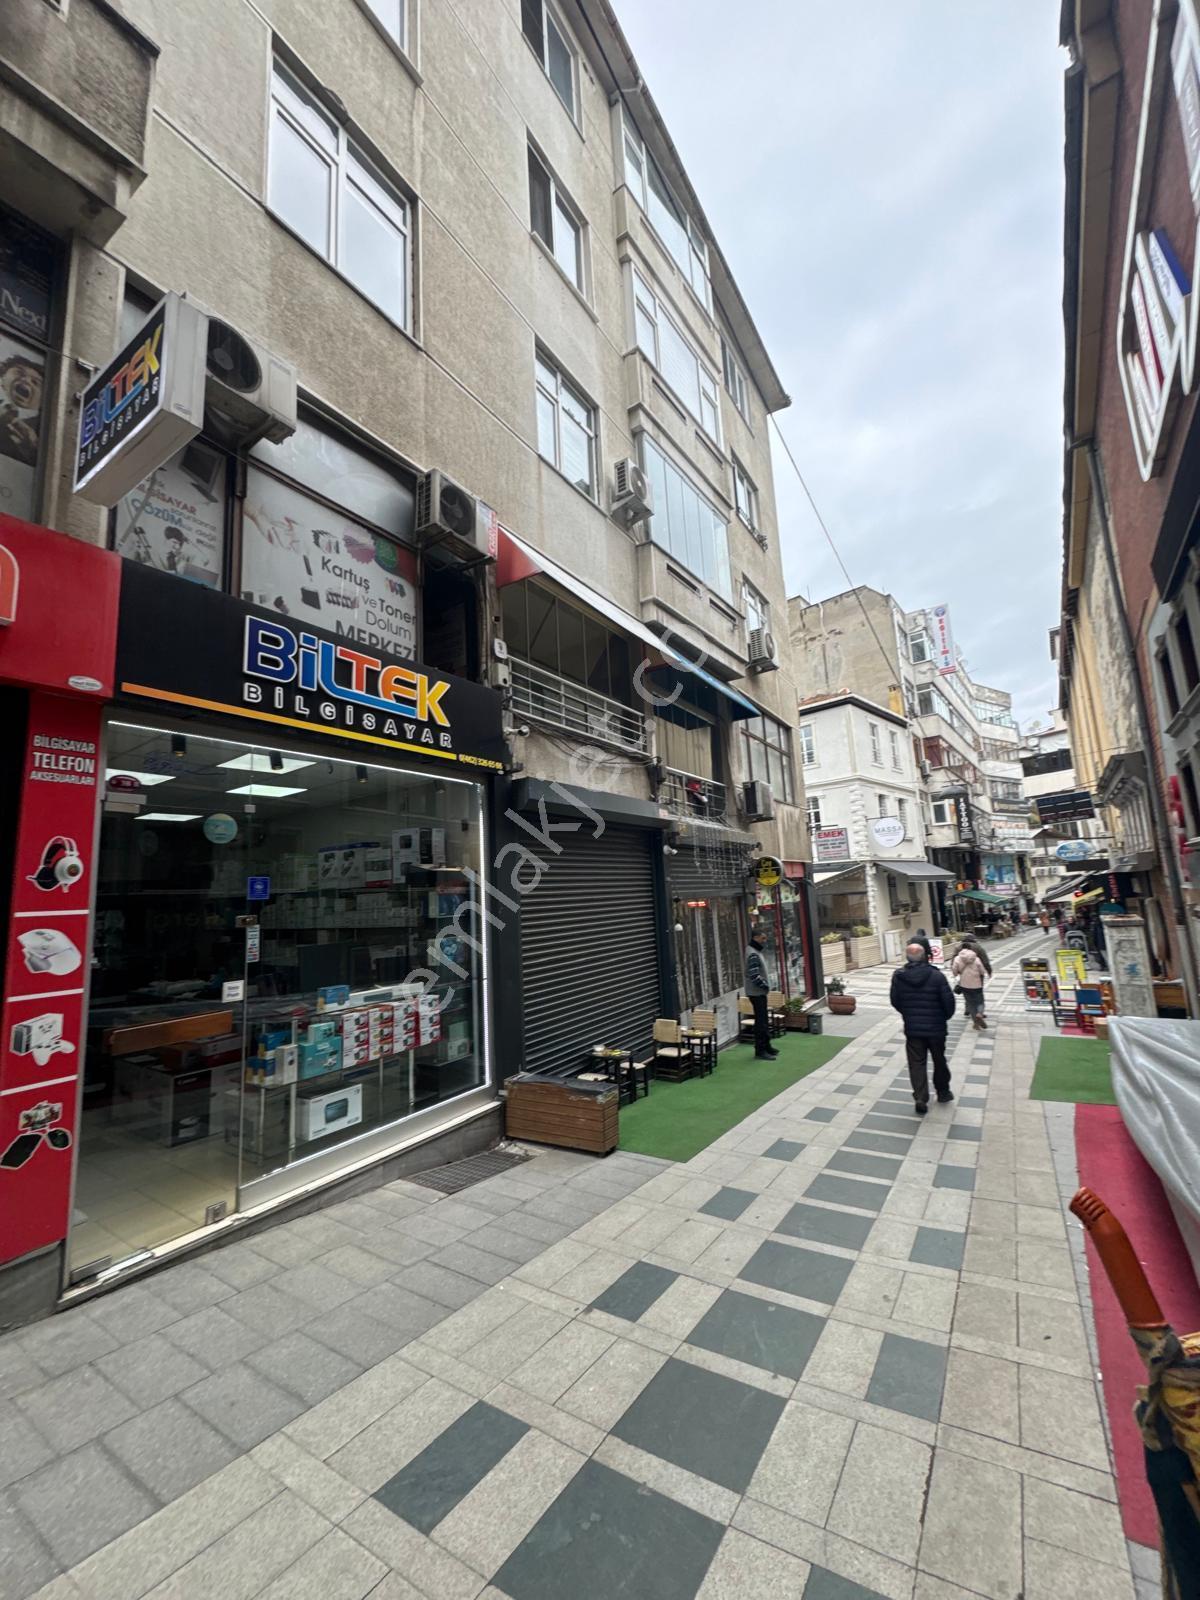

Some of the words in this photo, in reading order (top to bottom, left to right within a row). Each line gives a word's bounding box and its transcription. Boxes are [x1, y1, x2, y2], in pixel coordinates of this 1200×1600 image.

[321, 556, 370, 593] Kartuş
[361, 595, 378, 609] ve
[378, 598, 416, 625] Toner
[366, 610, 412, 642] Dolum
[32, 751, 96, 774] TELEFON
[817, 829, 845, 839] EMEK
